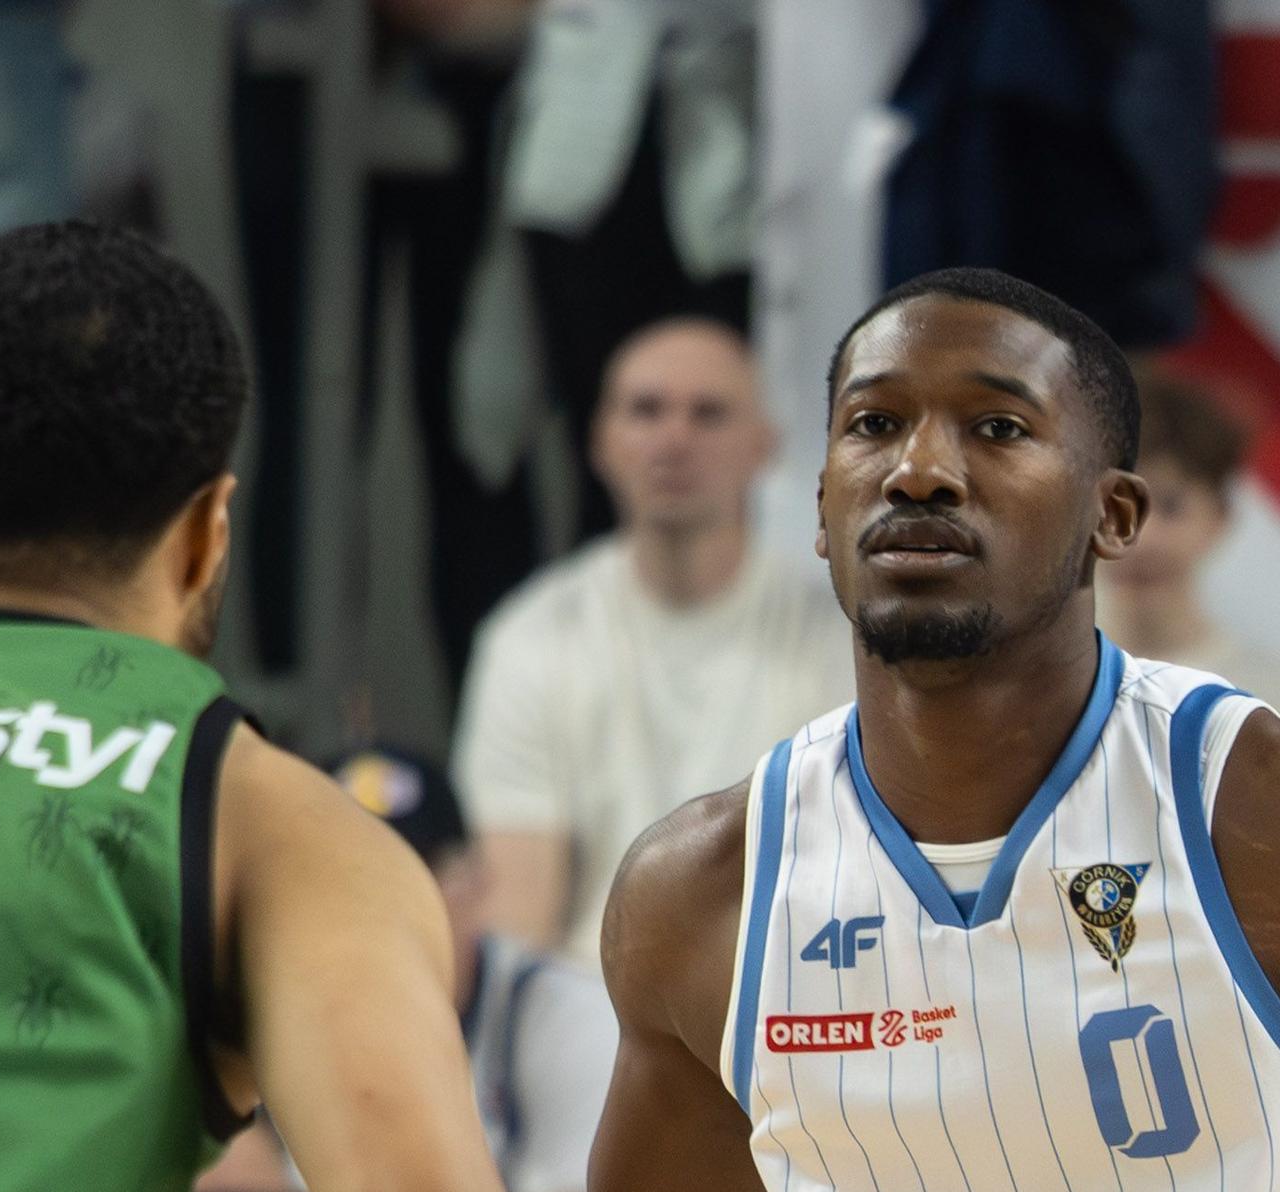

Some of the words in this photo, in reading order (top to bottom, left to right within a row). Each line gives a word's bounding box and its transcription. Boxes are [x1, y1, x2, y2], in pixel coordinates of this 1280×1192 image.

[800, 916, 885, 968] 4F
[770, 1021, 864, 1046] ORLEN
[911, 1005, 957, 1023] Basket
[913, 1026, 943, 1042] Liga
[1078, 1004, 1201, 1158] 0
